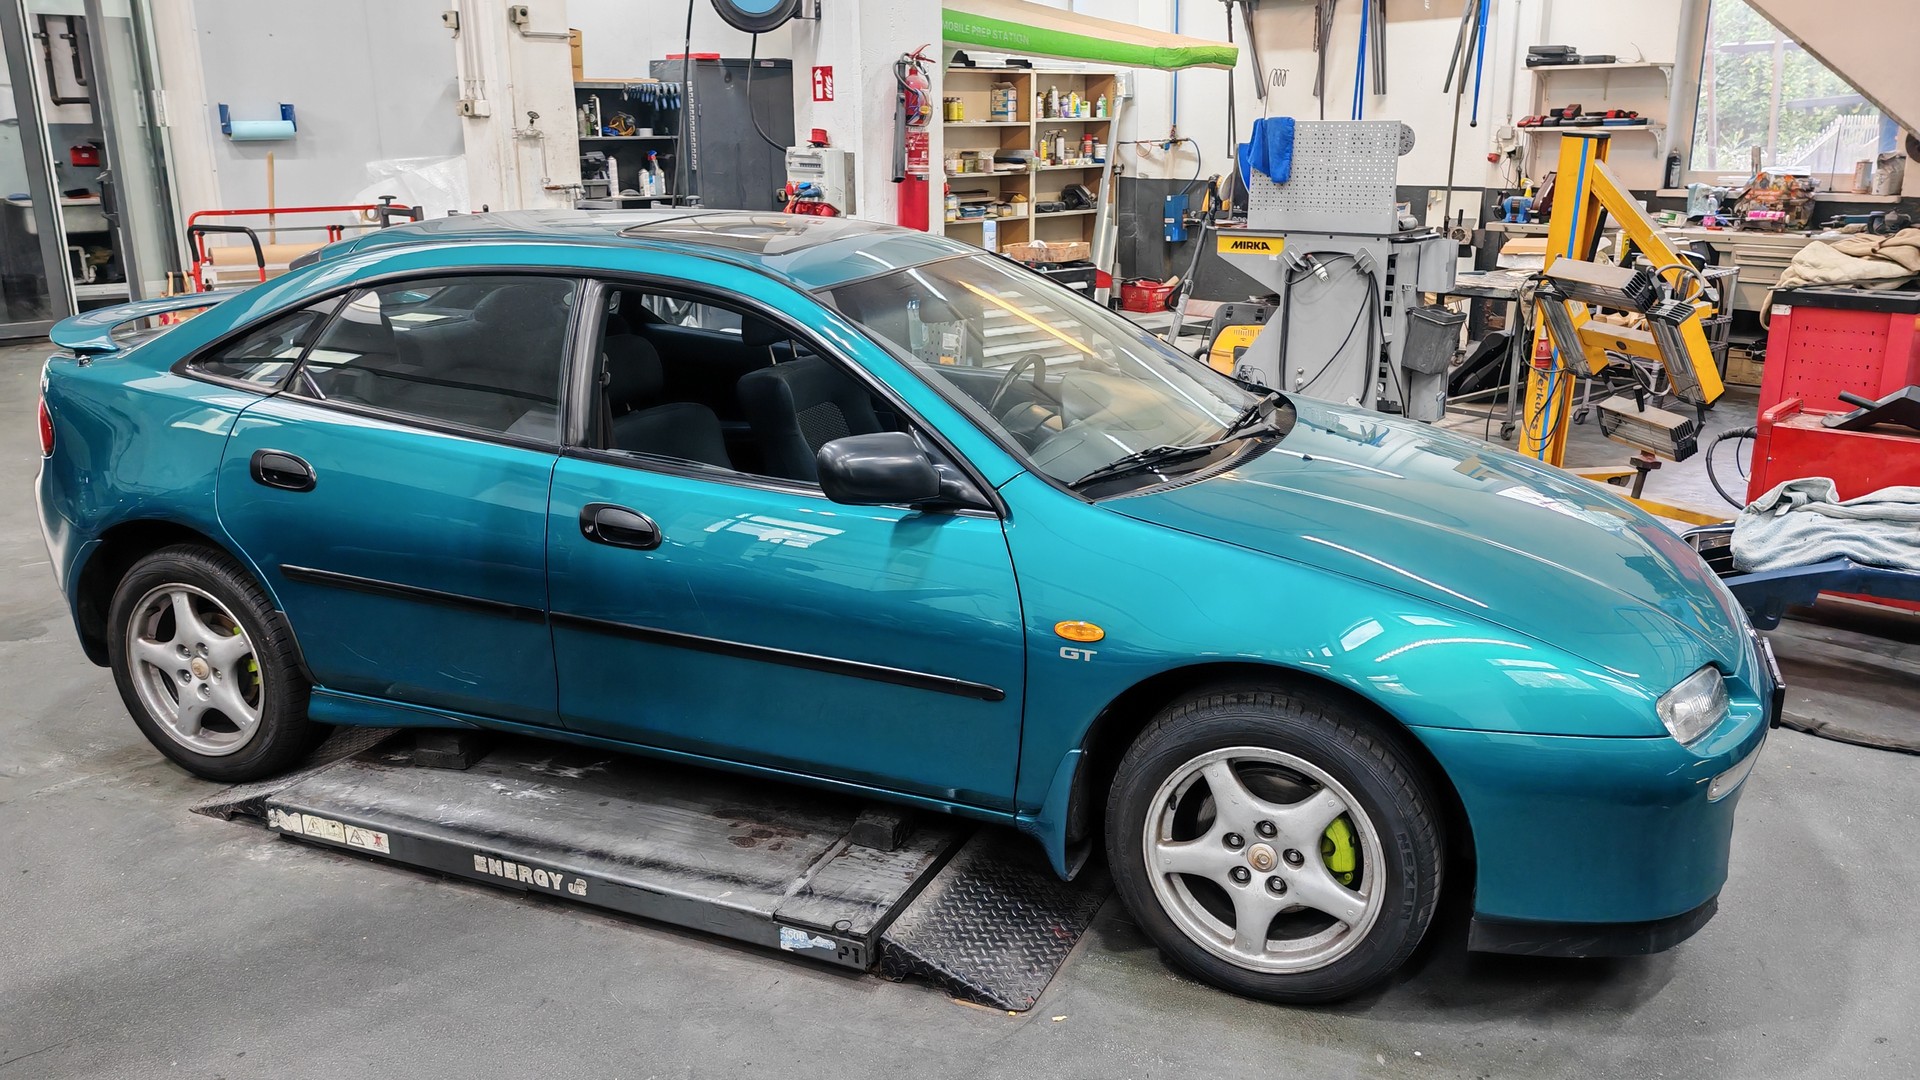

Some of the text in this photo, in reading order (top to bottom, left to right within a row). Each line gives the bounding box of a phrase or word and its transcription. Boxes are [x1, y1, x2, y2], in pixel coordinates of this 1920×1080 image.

[971, 25, 992, 38] PREP
[992, 30, 1030, 45] STATION
[1231, 241, 1271, 251] MIRKA
[1060, 646, 1098, 662] GT
[473, 854, 563, 890] ENERGY
[837, 945, 860, 964] P1
